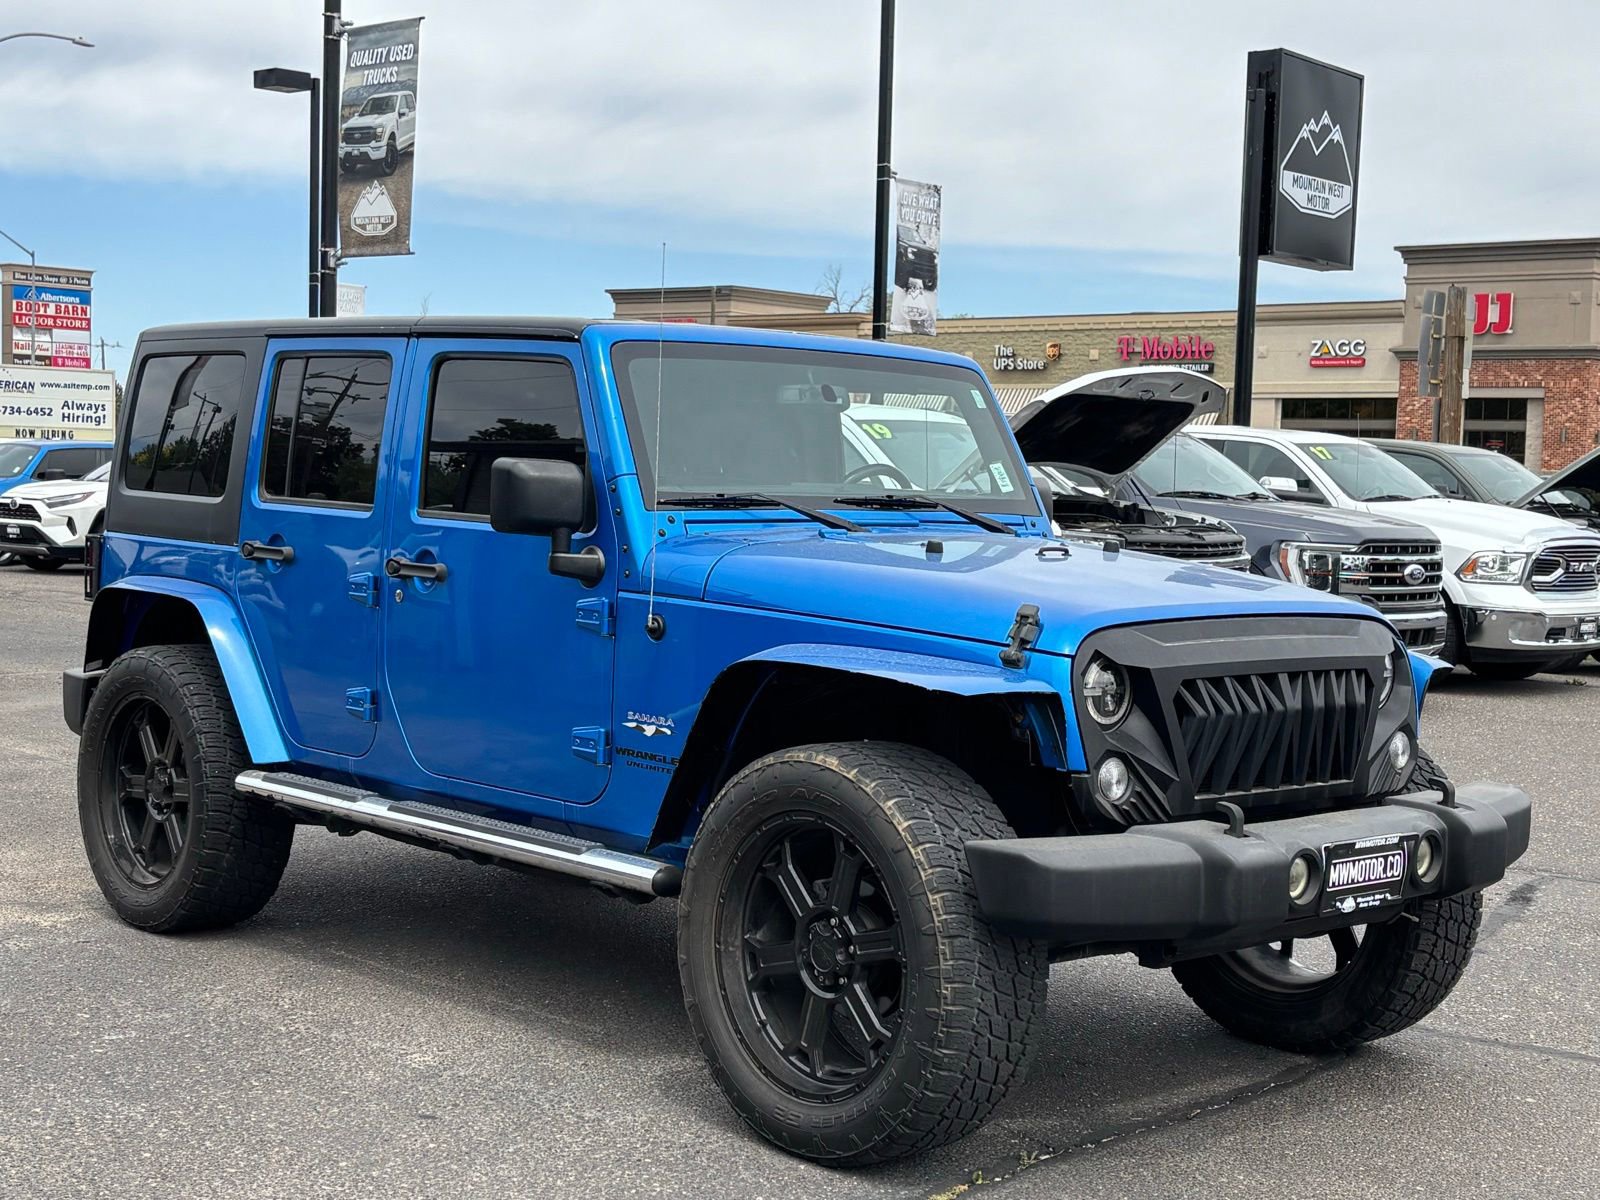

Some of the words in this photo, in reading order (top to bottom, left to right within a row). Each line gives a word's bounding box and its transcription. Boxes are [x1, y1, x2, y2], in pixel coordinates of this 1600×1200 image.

[350, 46, 389, 68] QUALITY
[390, 44, 414, 62] USED
[363, 66, 398, 86] TRUCKS
[1292, 174, 1326, 195] MOUNTAIN
[1328, 184, 1344, 199] WEST
[900, 192, 918, 206] LOVE
[918, 195, 938, 210] WHAT
[1306, 194, 1330, 210] MOTOR
[901, 206, 915, 221] YOU
[916, 210, 938, 225] DRIVE
[15, 272, 27, 280] Blue
[43, 274, 59, 283] Shops
[40, 292, 80, 304] Albertsons
[16, 301, 50, 314] BOOT
[55, 303, 88, 317] BARN
[1473, 292, 1514, 334] JJ
[15, 315, 55, 326] LIQUOR
[56, 319, 88, 329] STORE
[14, 341, 32, 351] Nail
[35, 343, 50, 353] Plus
[994, 344, 1013, 356] The
[1116, 335, 1215, 361] T-Mobile
[1310, 340, 1365, 356] ZAGG
[993, 358, 1015, 370] UPS
[1016, 358, 1044, 370] Store
[0, 380, 35, 391] ERICAN
[40, 382, 110, 391] www.asitemp.com
[61, 400, 106, 414] Always
[62, 413, 106, 426] Hiring!
[16, 429, 35, 438] NOW
[41, 430, 74, 440] HIRING
[862, 422, 892, 440] 19
[1309, 446, 1334, 460] 17
[627, 711, 675, 727] SAHARA
[615, 746, 680, 768] WRANGLE
[626, 760, 674, 775] UNLIMITE
[1329, 855, 1401, 887] MWMOTOR.CO
